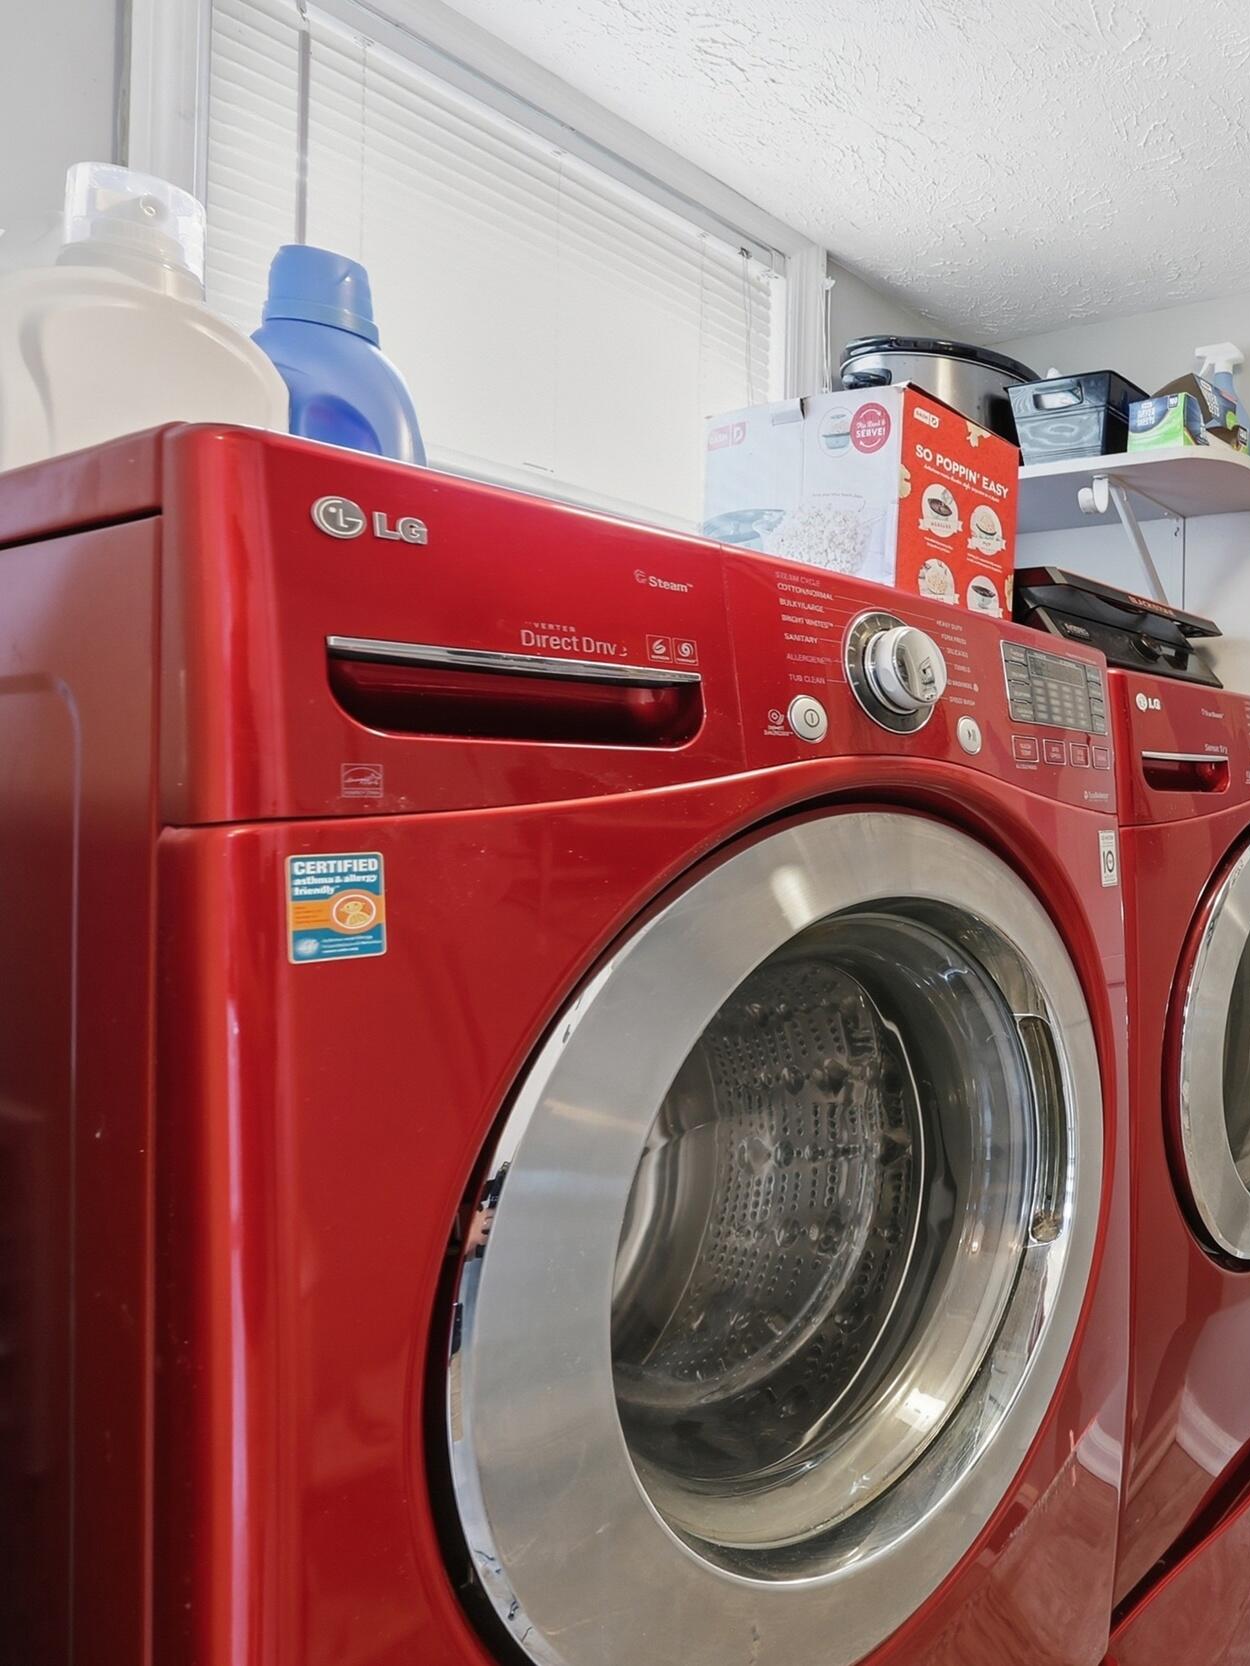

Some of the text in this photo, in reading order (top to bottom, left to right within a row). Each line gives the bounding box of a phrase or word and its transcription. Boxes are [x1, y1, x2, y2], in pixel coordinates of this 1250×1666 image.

[856, 427, 887, 438] SERVE!
[915, 444, 1009, 498] SO POPPIN' EASY
[372, 511, 428, 545] LG
[525, 621, 576, 632] VERTER
[520, 629, 580, 652] Direct
[784, 632, 818, 644] SANITARY
[803, 675, 826, 685] CLEAN
[1148, 697, 1161, 710] LG
[293, 858, 378, 875] CERTIFIED
[293, 874, 378, 886] asthma & allergy
[293, 885, 334, 896] friendly
